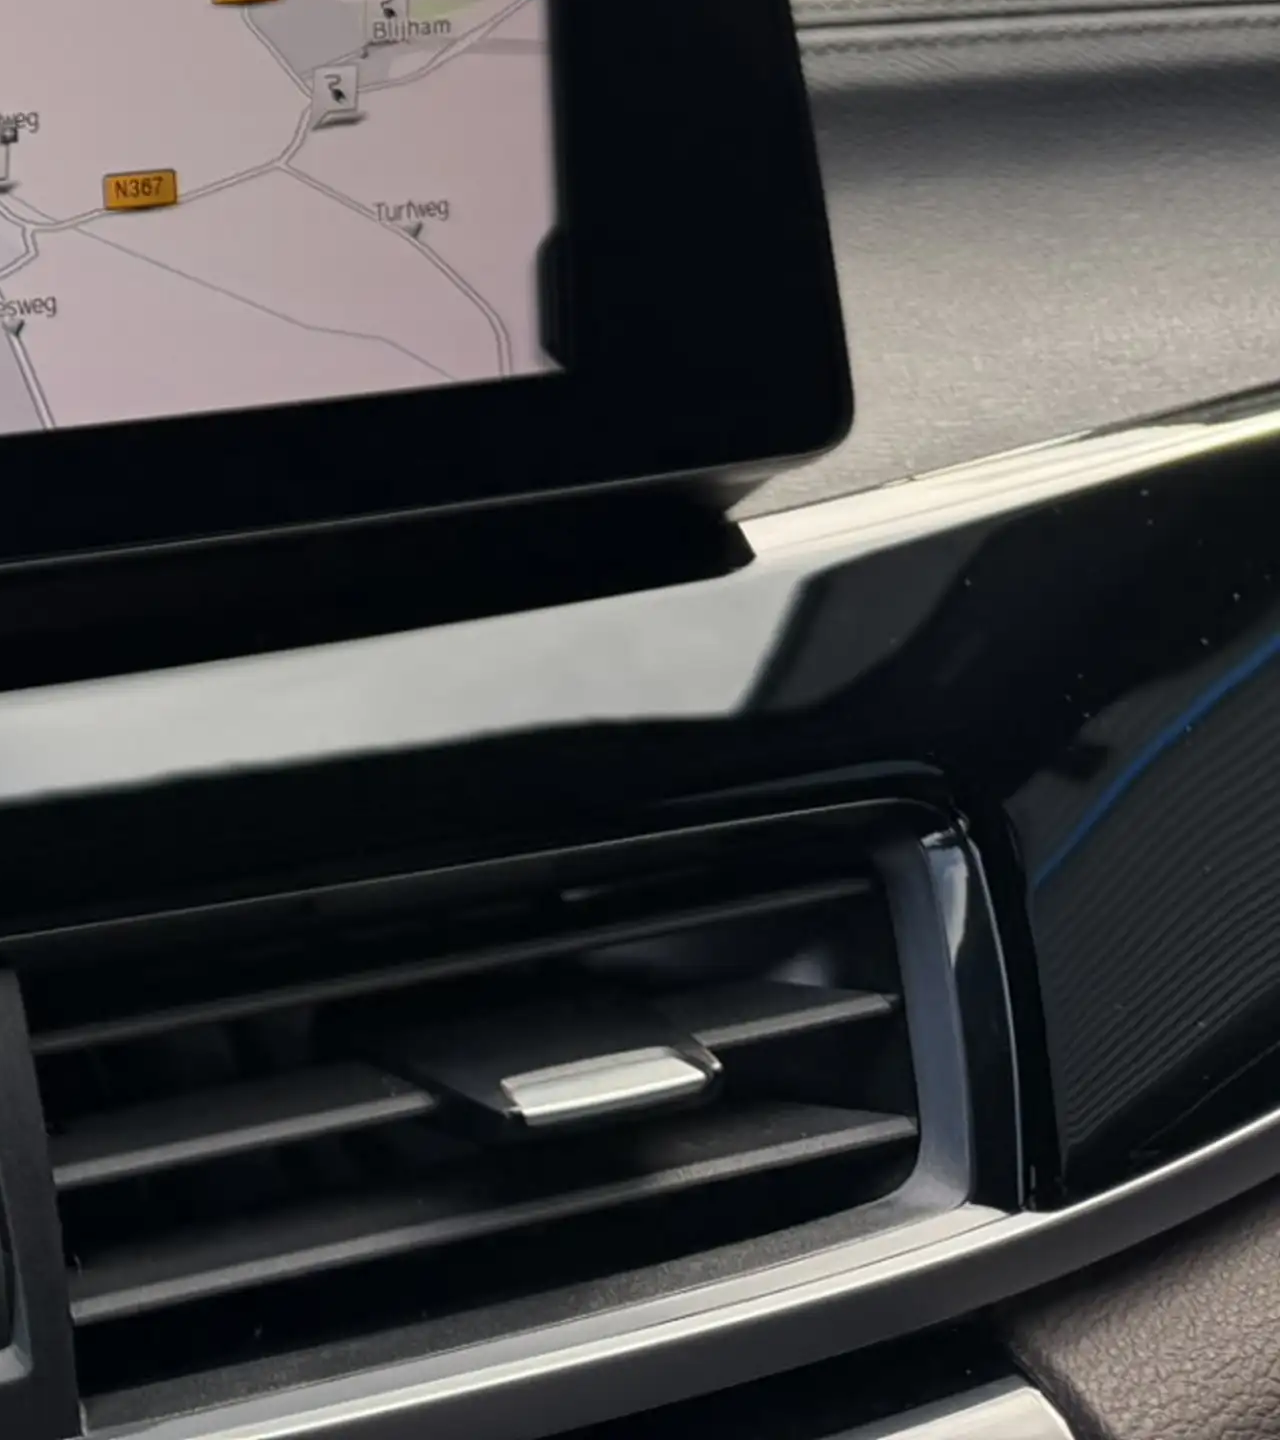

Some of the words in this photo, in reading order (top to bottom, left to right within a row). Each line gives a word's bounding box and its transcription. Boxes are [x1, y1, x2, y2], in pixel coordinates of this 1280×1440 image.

[372, 15, 452, 43] Blijham
[115, 176, 164, 199] N367
[374, 196, 450, 224] Turfweg
